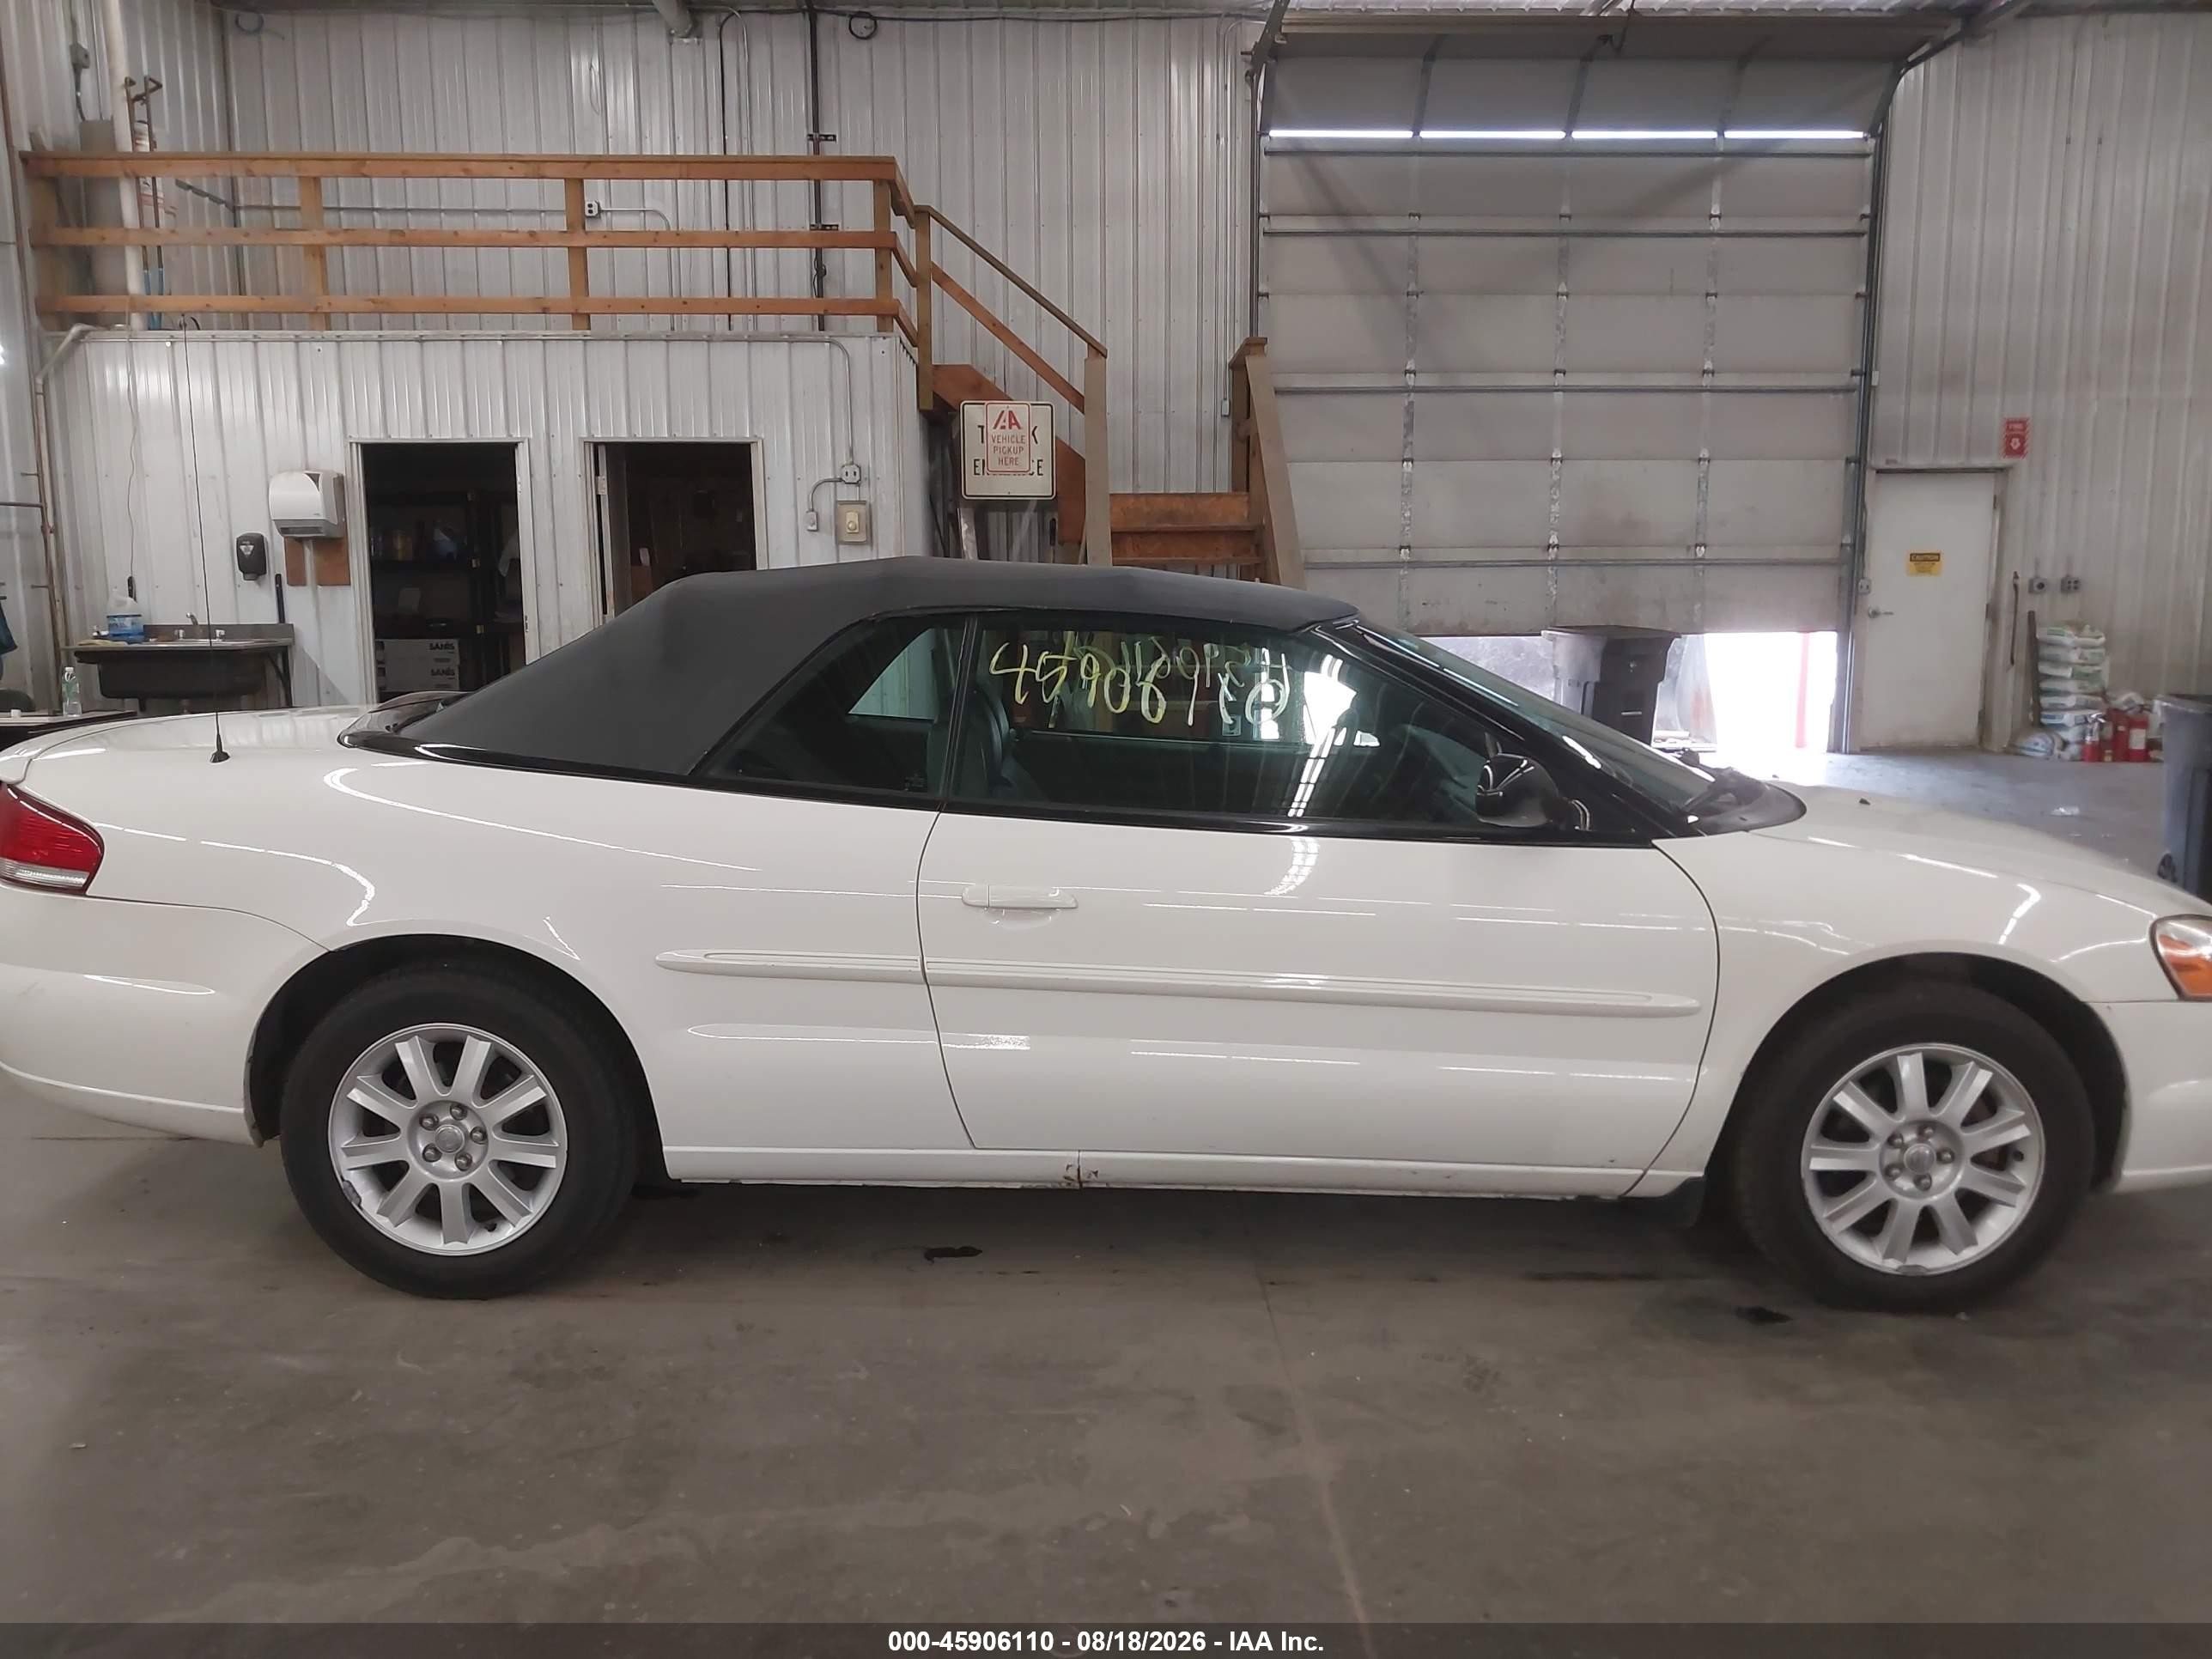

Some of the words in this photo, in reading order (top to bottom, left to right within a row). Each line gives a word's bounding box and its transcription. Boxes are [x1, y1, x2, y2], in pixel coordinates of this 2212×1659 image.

[991, 434, 1026, 445] VEHICLE
[993, 446, 1024, 455] PICKUP
[998, 456, 1019, 466] HERE
